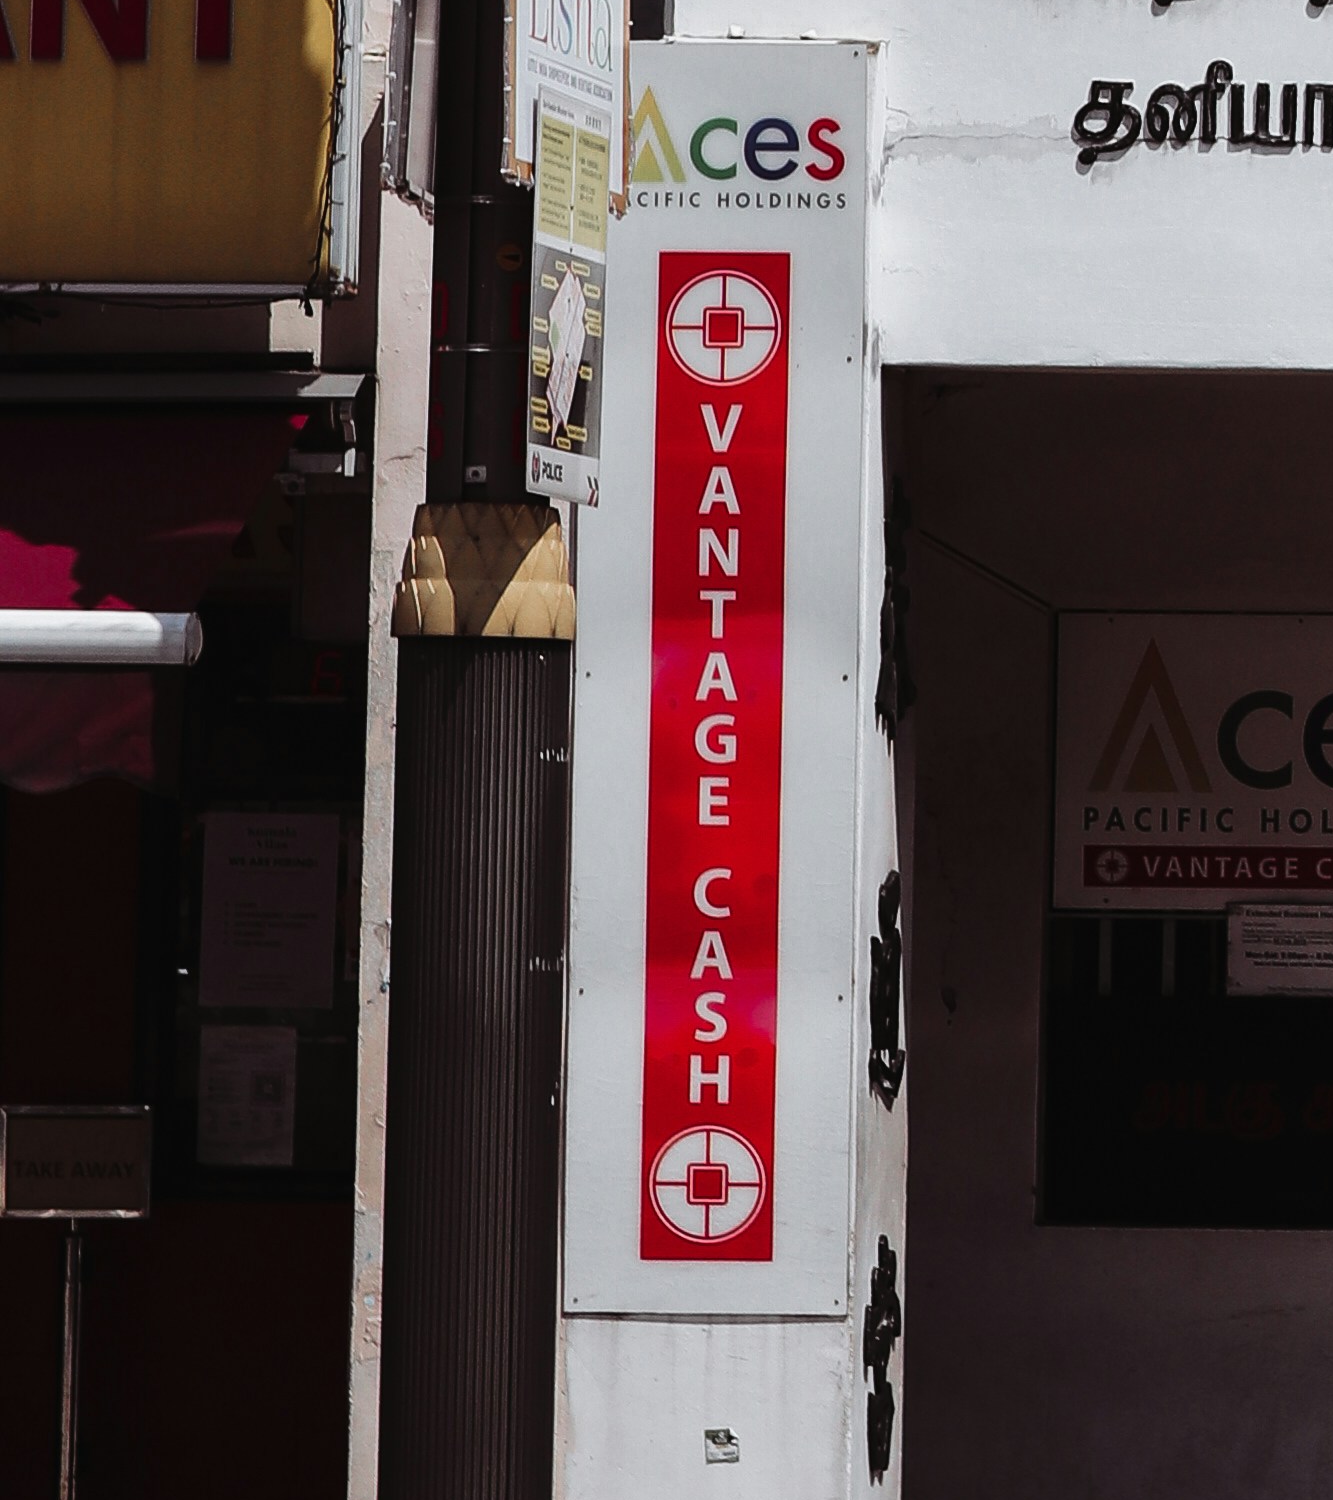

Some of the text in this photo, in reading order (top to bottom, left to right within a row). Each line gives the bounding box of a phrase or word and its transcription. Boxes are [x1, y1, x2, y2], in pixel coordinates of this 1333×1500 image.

[717, 191, 847, 210] HOLDINGS
[542, 460, 563, 483] POLICE
[688, 403, 744, 1105] VANTAGE CASH
[1083, 807, 1235, 834] PACIFIC
[1142, 855, 1300, 881] VANTAGE
[14, 1160, 134, 1179] TAKE AWAY
